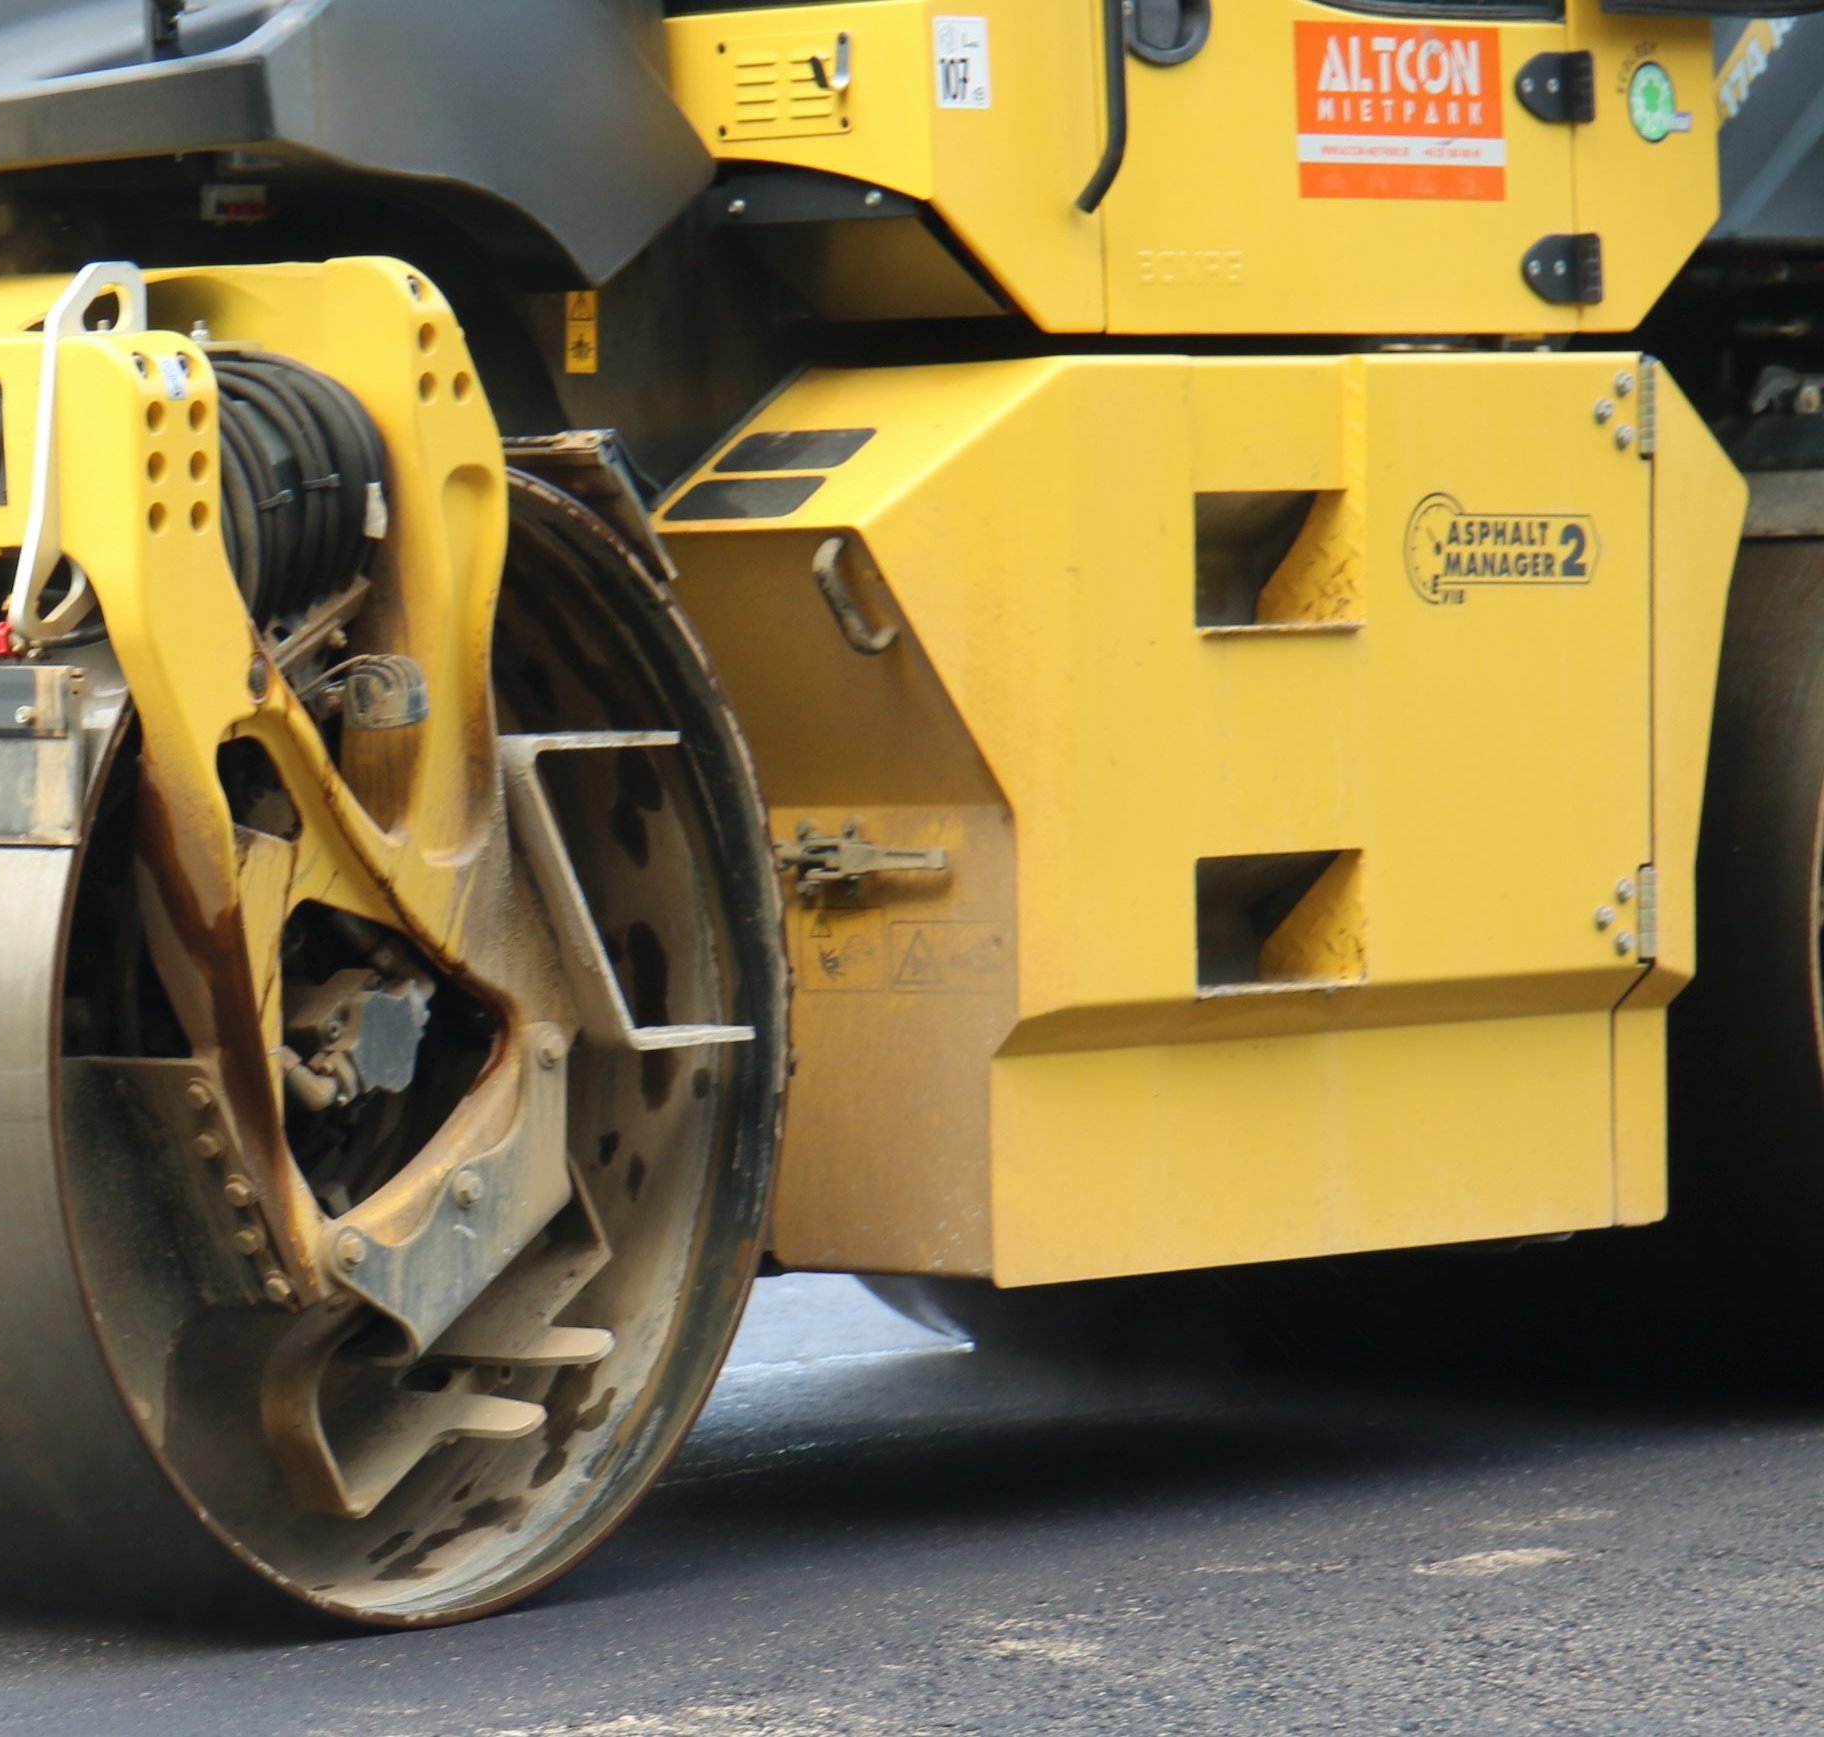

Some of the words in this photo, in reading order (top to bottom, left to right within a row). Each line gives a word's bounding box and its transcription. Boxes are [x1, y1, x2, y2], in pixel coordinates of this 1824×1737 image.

[1317, 35, 1480, 96] ALTCON
[1317, 97, 1483, 126] MIETPARK
[1446, 520, 1548, 545] ASPHALT
[1444, 551, 1555, 577] MANAGER
[1560, 522, 1586, 577] 2
